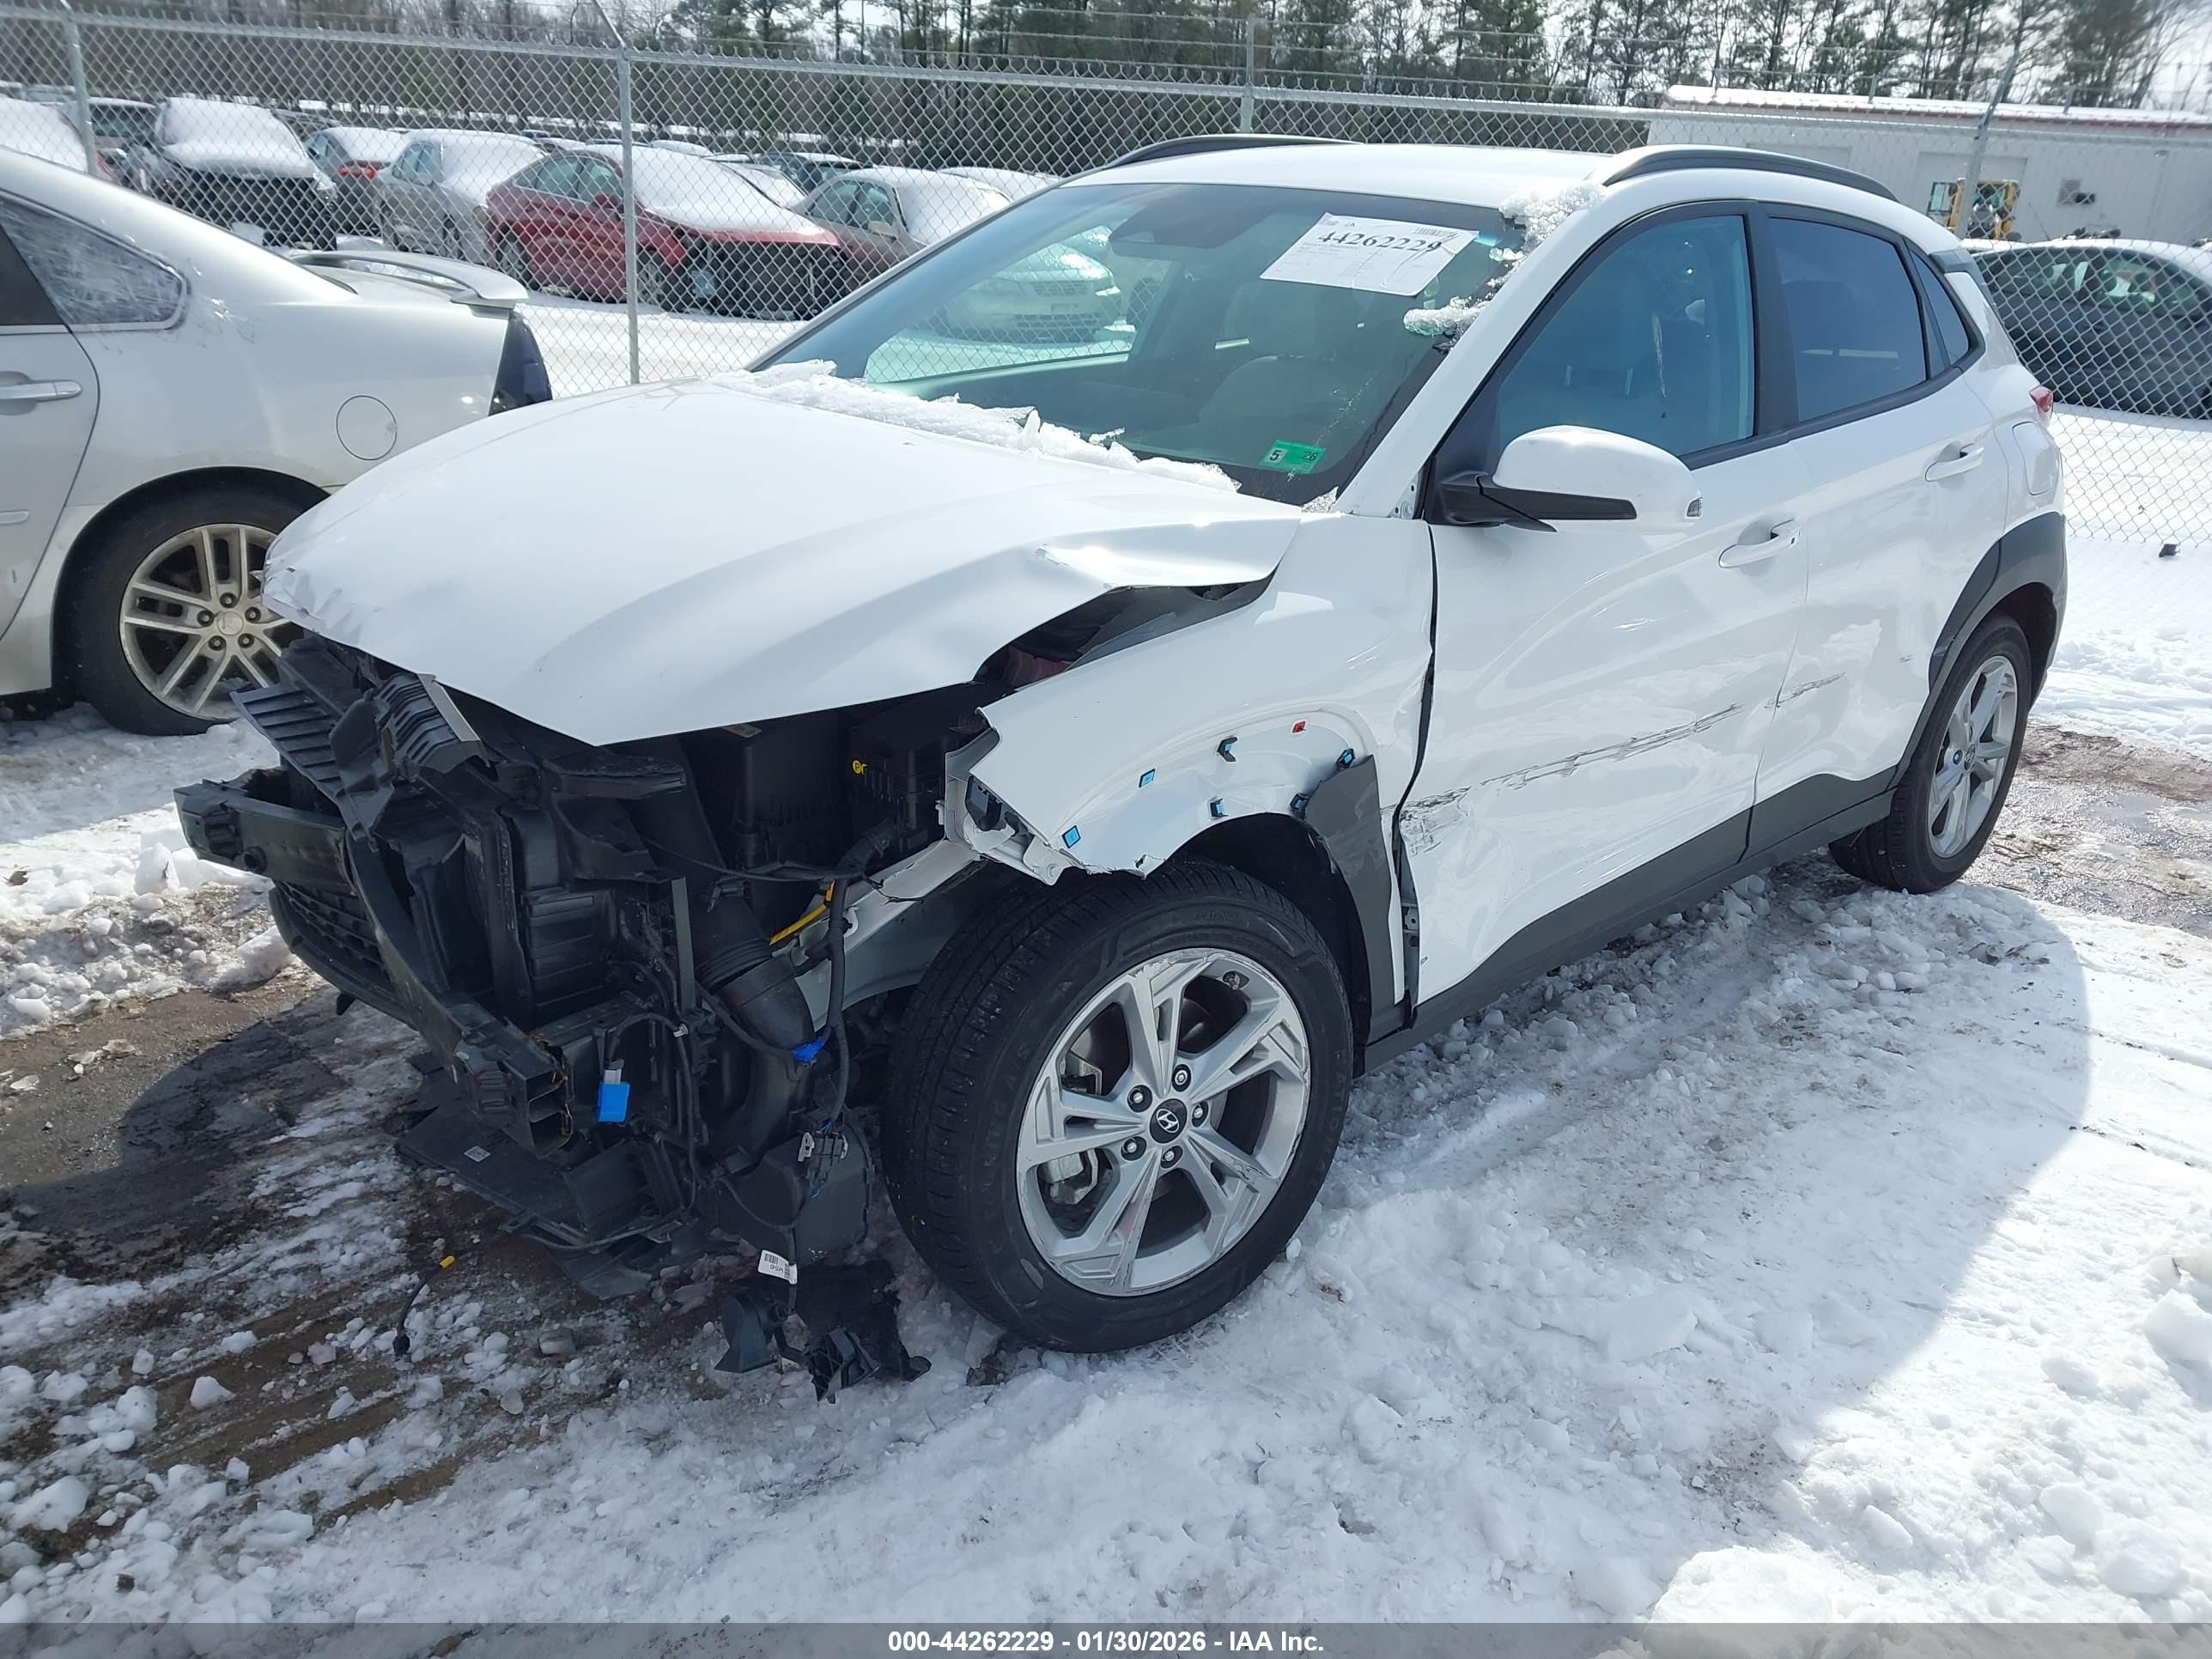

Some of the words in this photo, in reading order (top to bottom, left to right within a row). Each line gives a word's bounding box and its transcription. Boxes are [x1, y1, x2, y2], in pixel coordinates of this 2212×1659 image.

[1317, 230, 1443, 252] 44262229
[1269, 449, 1282, 461] 5
[1302, 451, 1319, 461] 26
